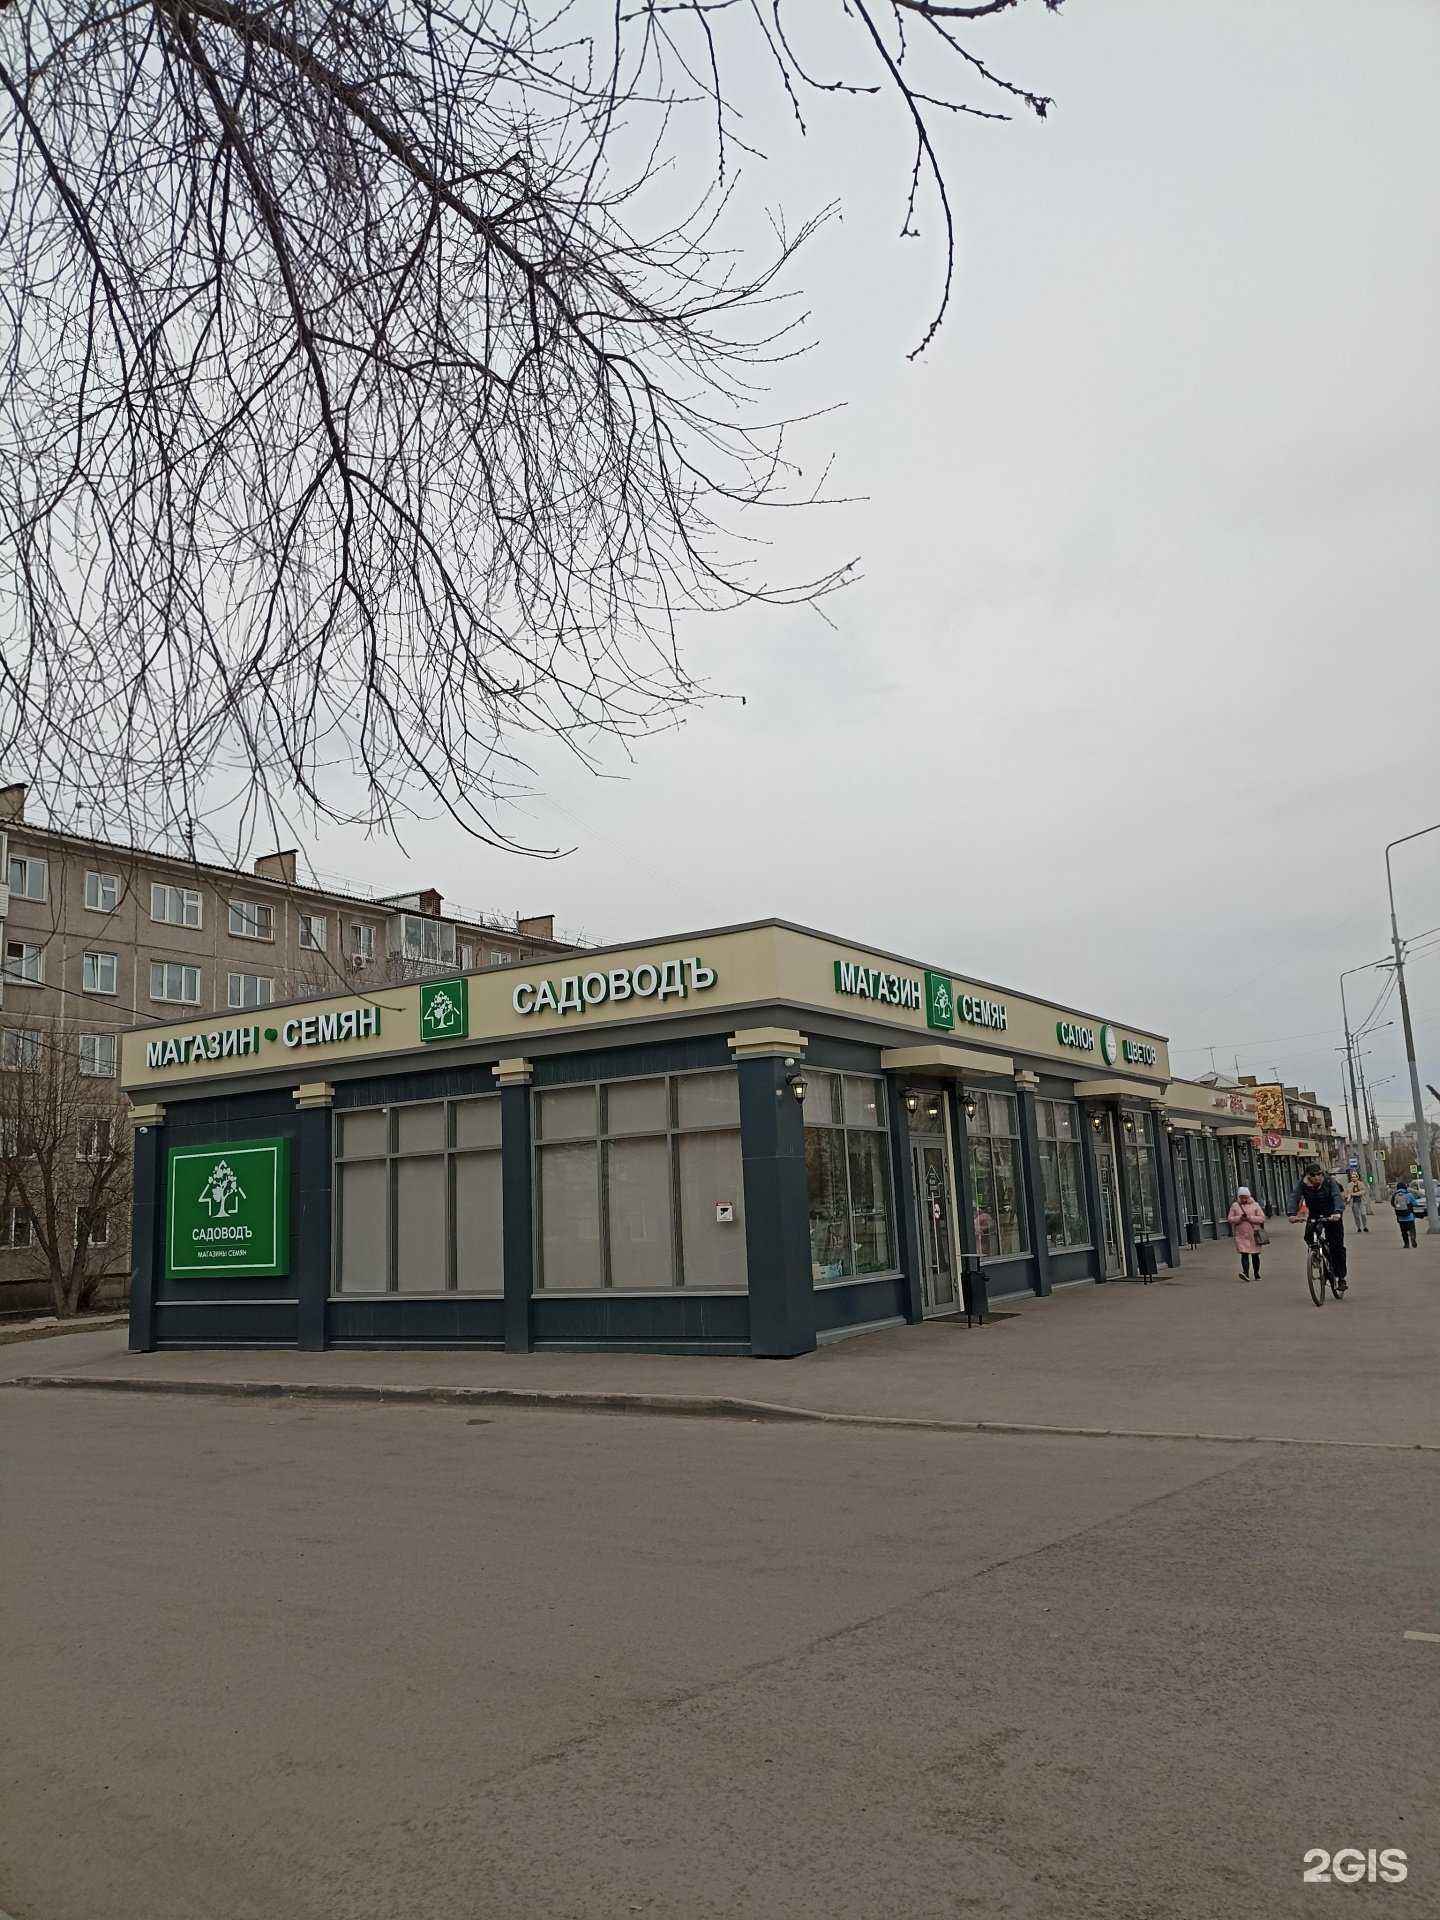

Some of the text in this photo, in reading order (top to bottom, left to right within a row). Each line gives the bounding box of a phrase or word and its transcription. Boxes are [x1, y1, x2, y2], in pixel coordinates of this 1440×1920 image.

[512, 957, 716, 1015] САДОВОДЪ
[836, 960, 1008, 1031] МАГАЗИН СЕМЯН
[146, 1007, 379, 1068] МАГАЗИН СЕМЯН
[1059, 1021, 1157, 1065] САЛОН ЦВЕТОВ
[192, 1226, 253, 1242] САДОВОДЪ
[197, 1248, 248, 1258] МАГАЗИНЫ СЕМЯН
